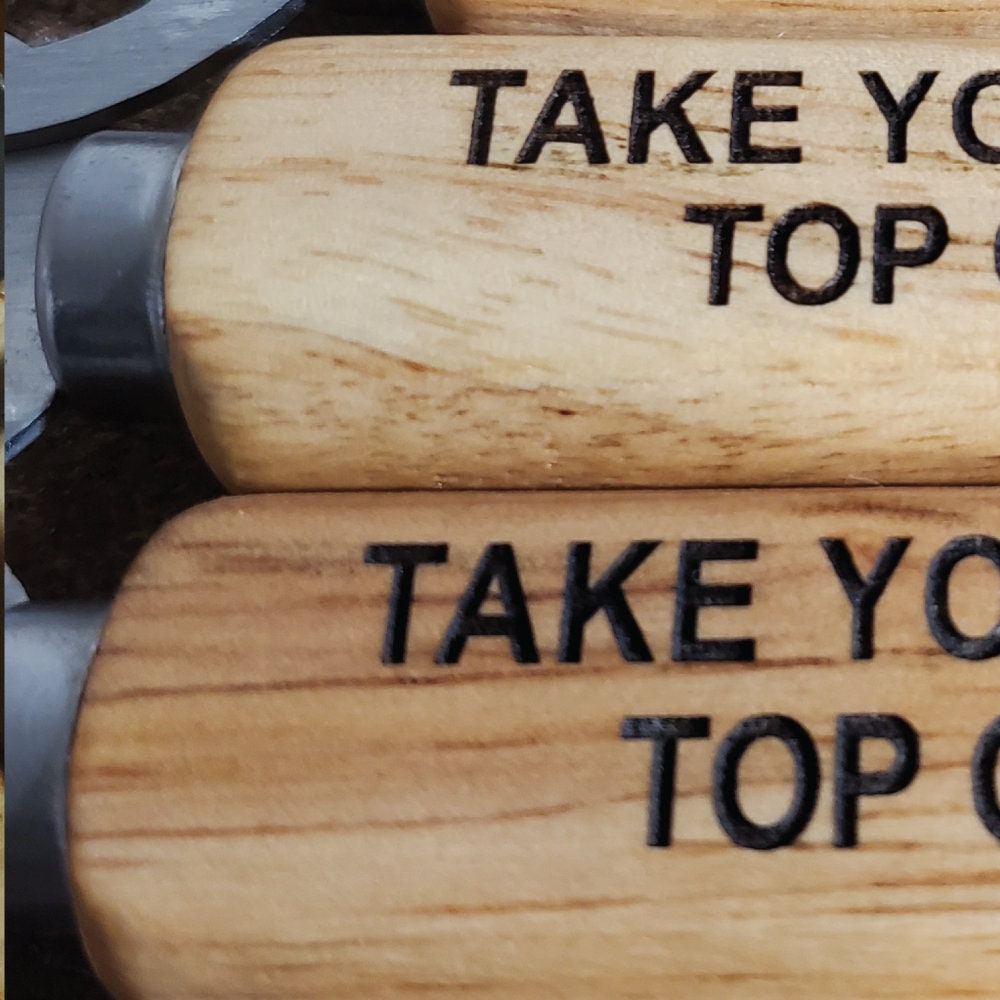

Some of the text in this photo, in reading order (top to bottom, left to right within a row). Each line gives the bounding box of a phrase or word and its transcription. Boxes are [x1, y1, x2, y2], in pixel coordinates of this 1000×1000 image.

[449, 68, 802, 167] TAKE
[683, 202, 949, 307] TOP
[363, 538, 761, 667] TAKE
[620, 712, 921, 850] TOP
